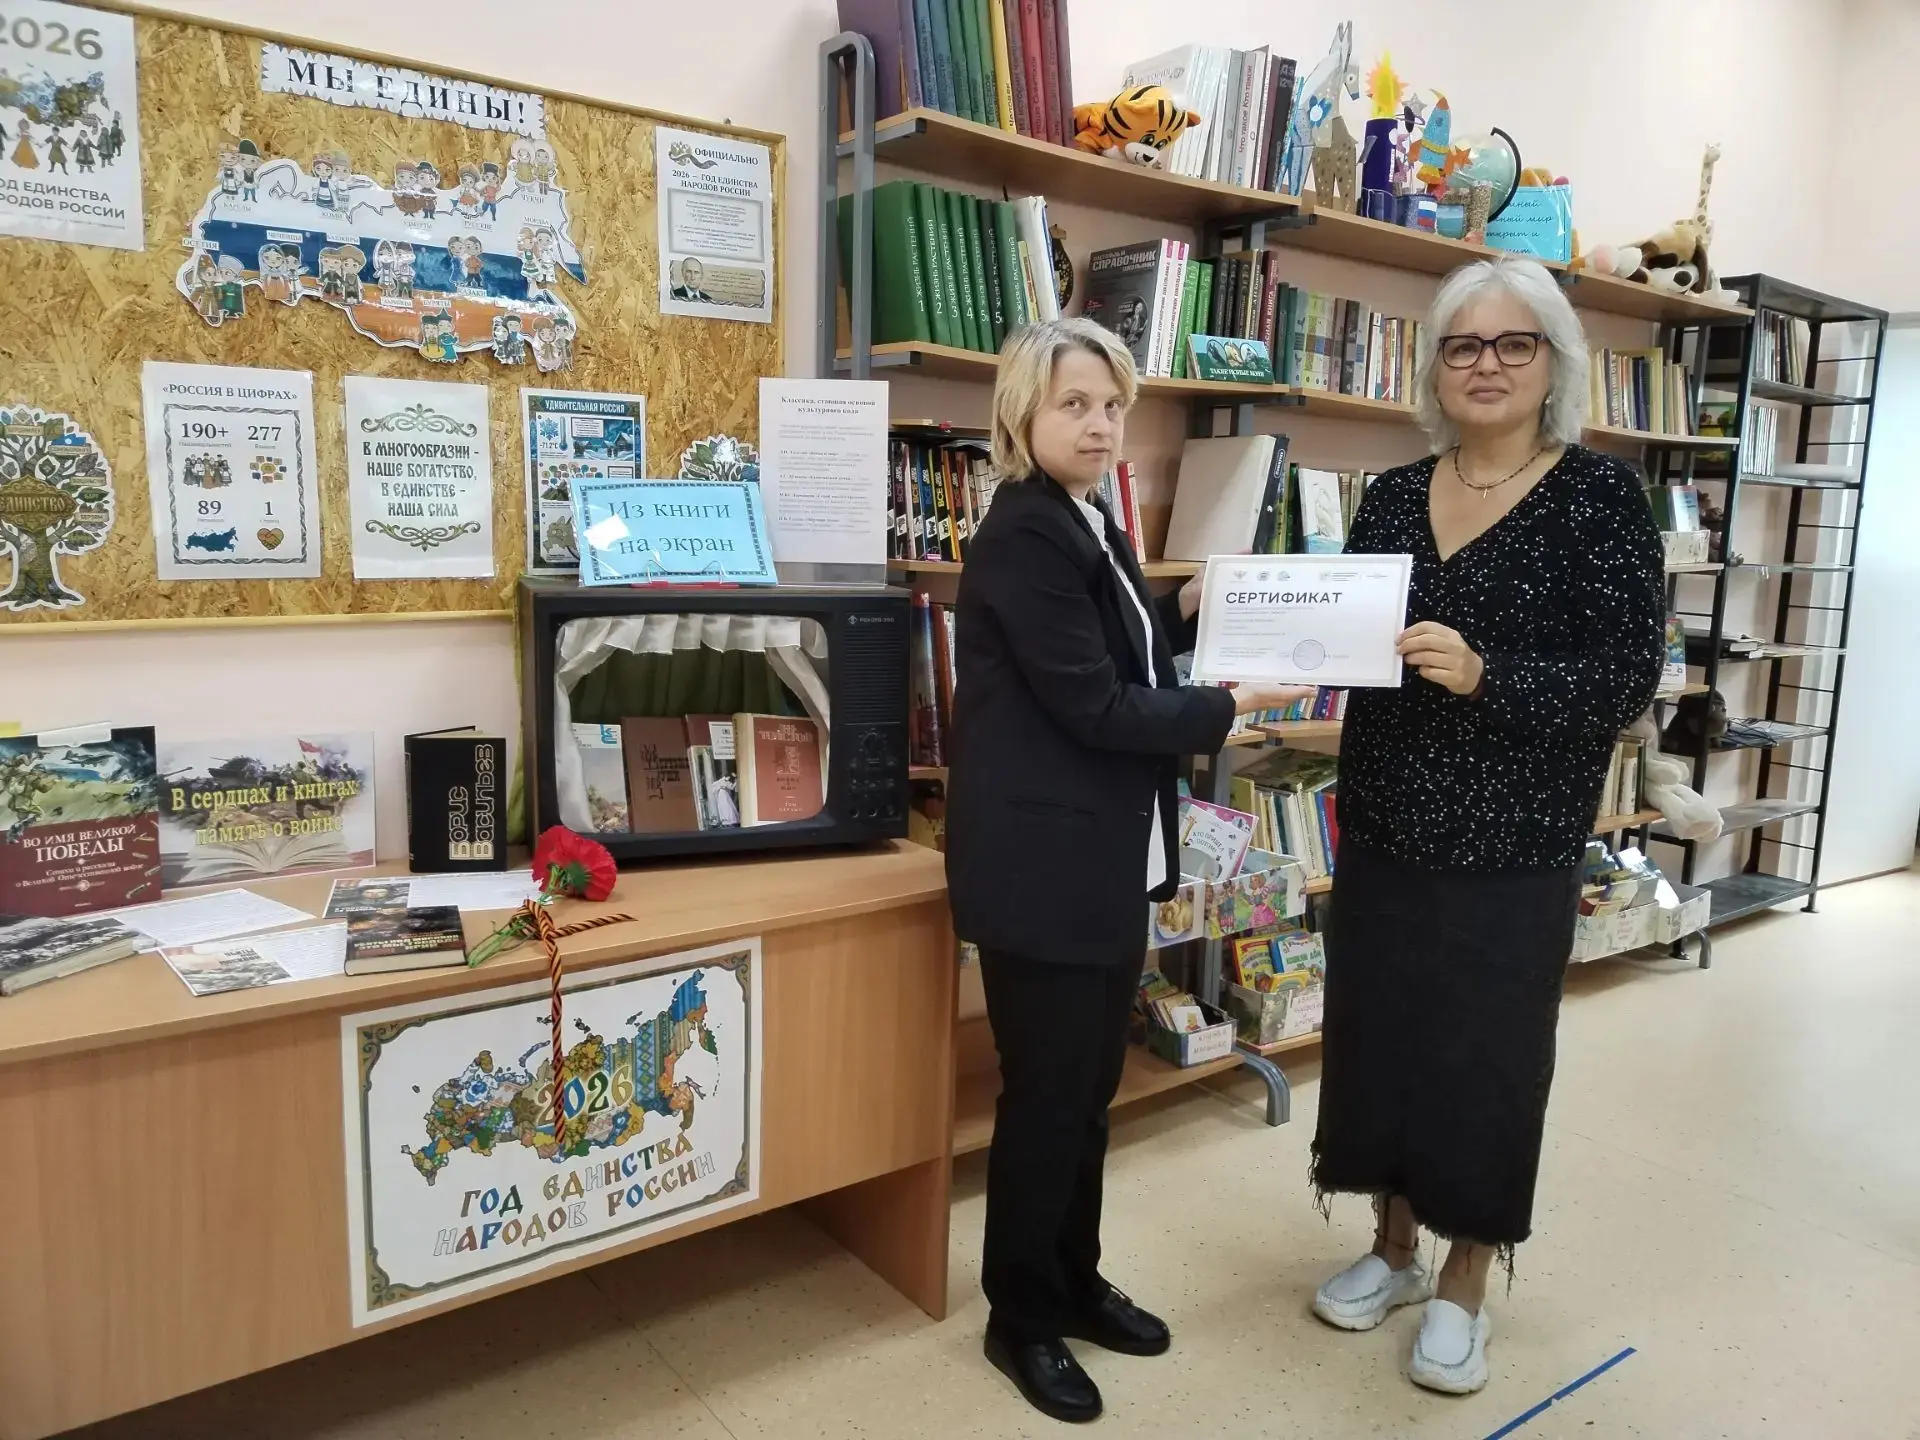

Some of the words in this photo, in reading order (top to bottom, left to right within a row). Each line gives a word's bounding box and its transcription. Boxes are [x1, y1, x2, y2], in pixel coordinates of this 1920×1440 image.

[0, 16, 103, 60] 026
[288, 58, 354, 93] МЫ
[375, 74, 525, 124] ЕДИНЫ!
[695, 147, 759, 165] ОФИЦИАЛЬНО
[672, 170, 690, 179] 2026
[701, 173, 717, 183] ГОД
[718, 176, 758, 188] ЕДИНСТВА
[24, 182, 111, 203] ЕДИНСТВА
[681, 180, 718, 191] НАРОДОВ
[720, 185, 751, 197] РОССИИ
[59, 201, 125, 220] РОССИИ
[183, 239, 218, 249] ОСЕТИЯ
[1092, 251, 1156, 272] СПРАВОЧНИК
[918, 300, 925, 312] 1
[936, 301, 943, 314] 2
[951, 306, 958, 318] 3
[967, 307, 974, 318] 4
[163, 383, 223, 397] «РОССИЯ
[226, 386, 234, 397] В
[238, 387, 298, 400] ЦИФРАХ»
[545, 399, 599, 413] УДИВИТЕЛЬНАЯ
[599, 403, 625, 414] РОССИЯ
[182, 423, 229, 439] 190+
[247, 426, 282, 441] 277
[363, 441, 371, 456] В
[376, 442, 470, 459] МНОГООБРАЗИИ
[367, 462, 403, 477] НАШЕ
[407, 463, 477, 481] БОГАТСТВО,
[381, 482, 389, 496] В
[393, 483, 455, 499] ЕДИНСТВЕ
[198, 500, 222, 515] 89
[264, 501, 274, 515] 1
[388, 502, 424, 517] НАША
[428, 503, 459, 517] СИЛА
[608, 500, 645, 519] Из
[653, 503, 731, 519] книги
[619, 537, 649, 554] на
[658, 536, 735, 557] экран
[1225, 592, 1342, 604] СЕРТИФИКАТ
[171, 788, 185, 811] В
[191, 786, 270, 813] сердцах
[276, 786, 288, 801] и
[294, 780, 358, 800] книгах
[23, 838, 41, 848] ВО
[44, 833, 75, 845] ИМЯ
[79, 824, 137, 841] ВЕЛИКОЙ
[195, 822, 267, 845] память
[273, 823, 283, 836] о
[290, 811, 344, 837] войне
[36, 838, 125, 863] ПОБЕДЫ
[537, 1064, 634, 1126] 2026
[460, 1184, 524, 1218] ГОД
[543, 1130, 695, 1201] ЕДИНСТВА
[433, 1201, 587, 1256] НАРОДОВ
[607, 1152, 716, 1218] РОССИИ
